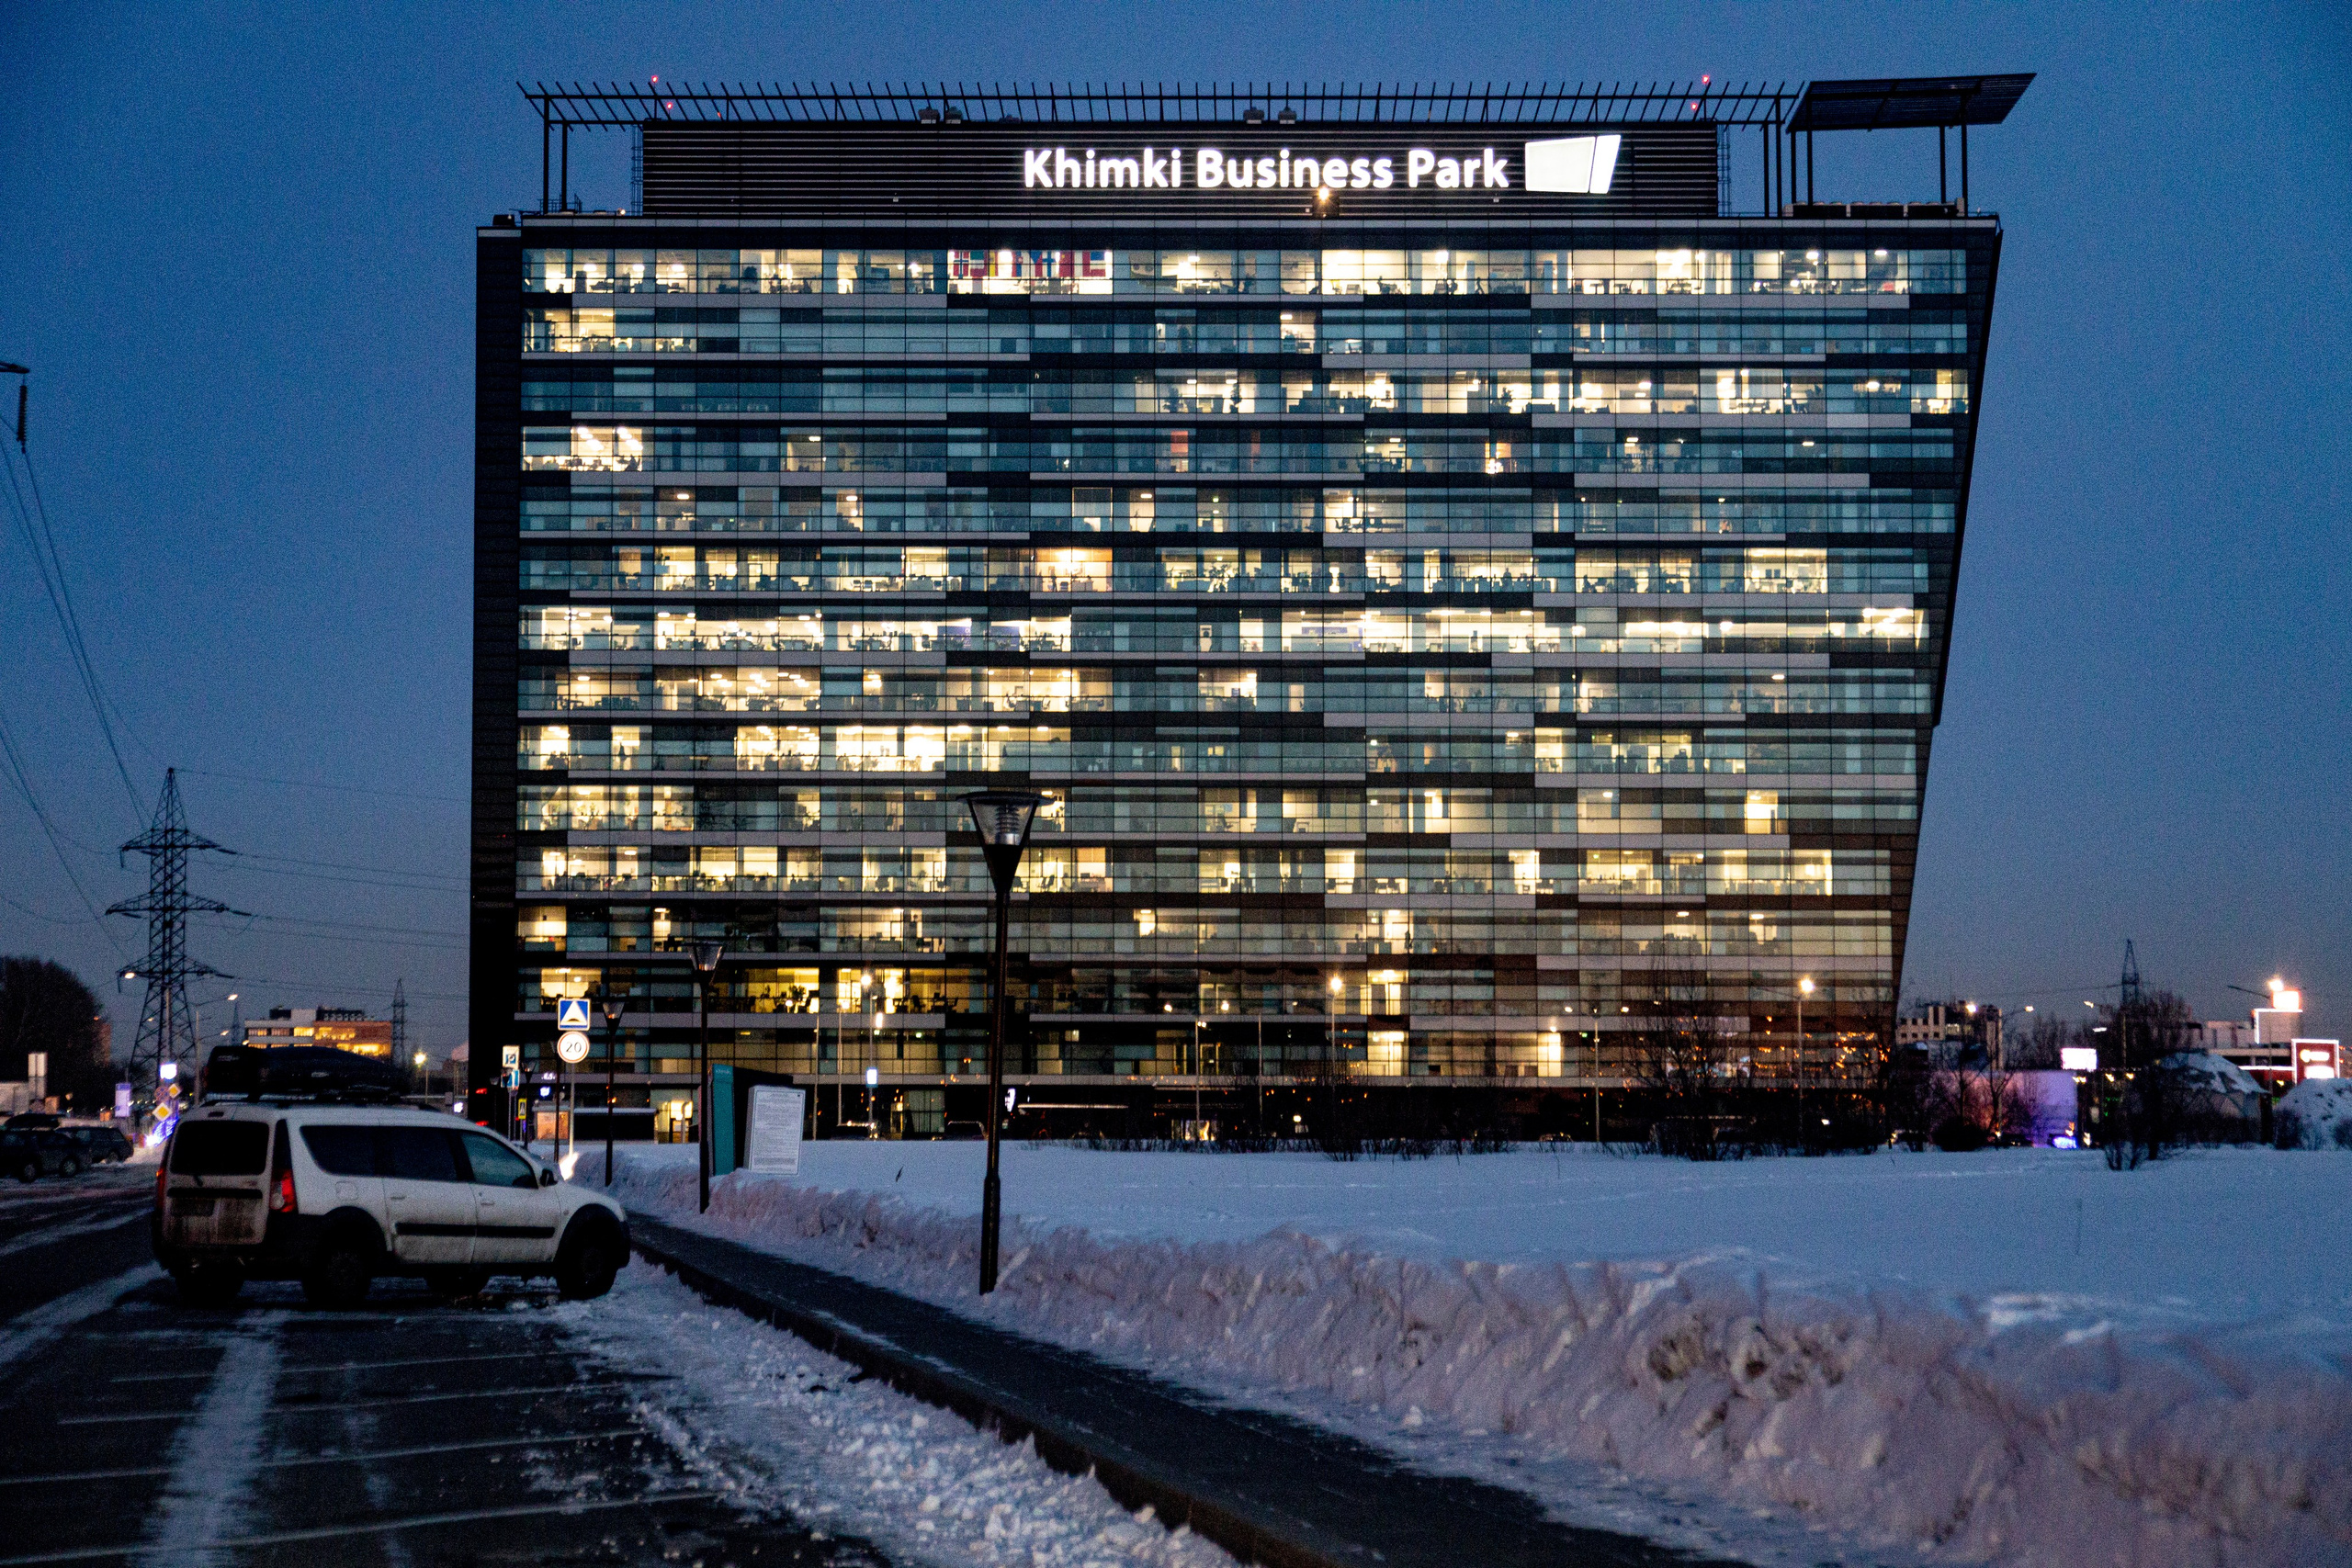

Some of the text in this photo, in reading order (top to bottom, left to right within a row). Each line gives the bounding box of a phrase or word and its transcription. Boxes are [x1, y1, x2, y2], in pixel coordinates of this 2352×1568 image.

[1023, 147, 1510, 189] Khimki Business Park
[566, 1042, 582, 1053] 20
